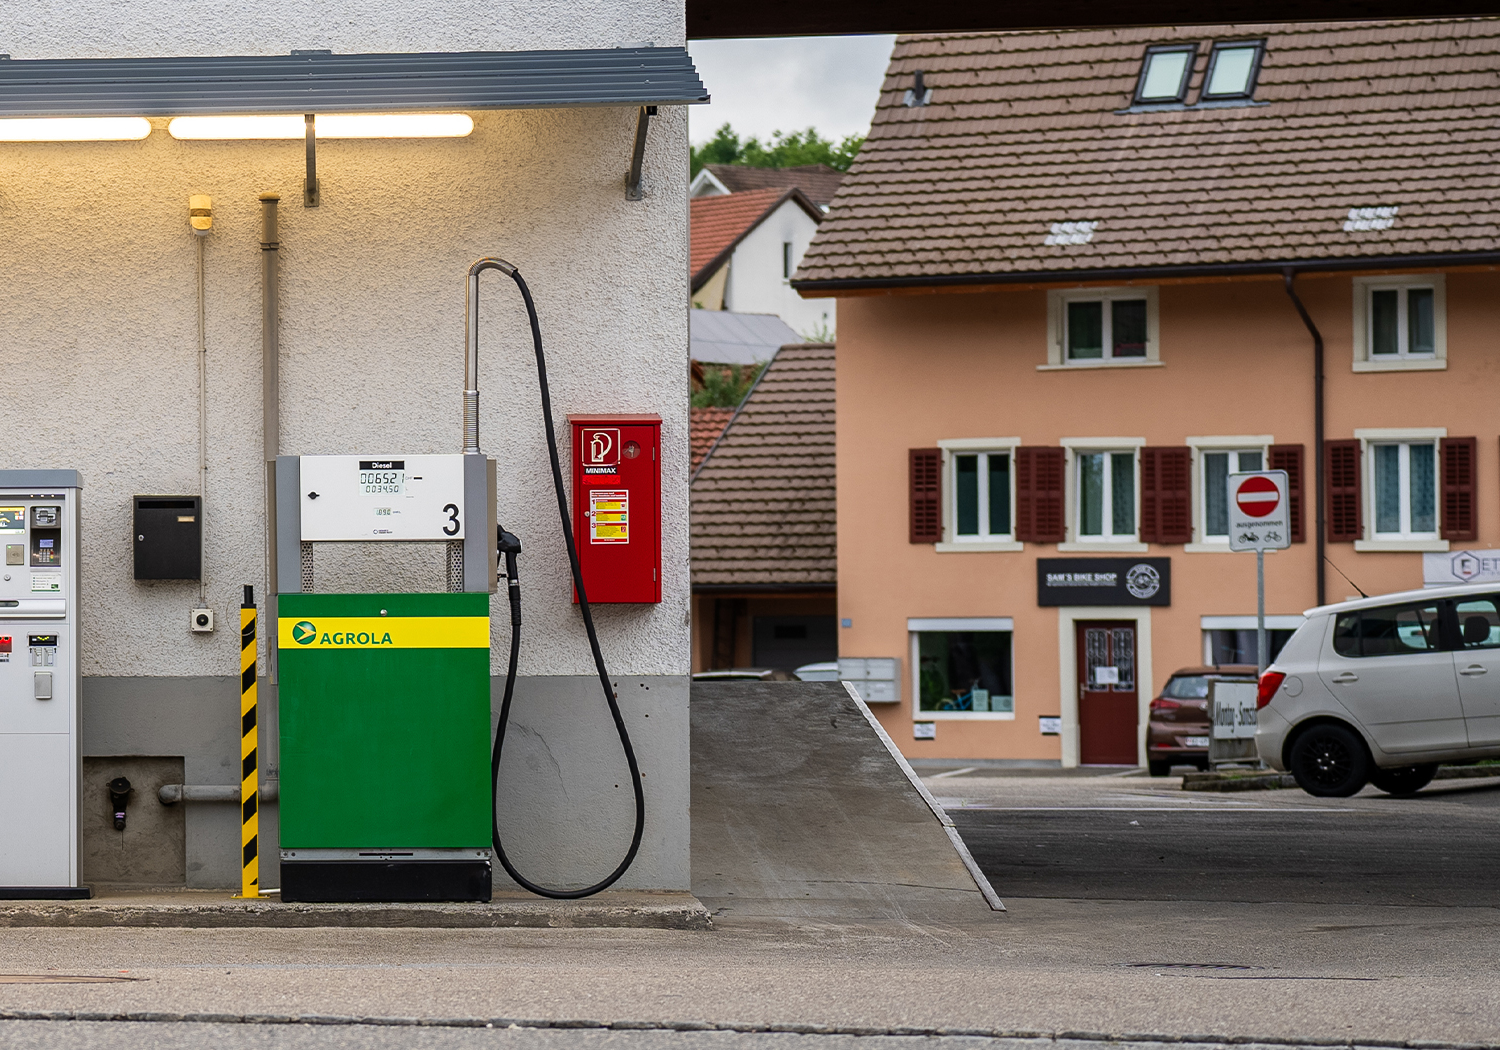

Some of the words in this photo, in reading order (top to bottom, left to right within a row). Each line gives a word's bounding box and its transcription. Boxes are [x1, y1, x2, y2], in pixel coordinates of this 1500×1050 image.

[443, 503, 460, 536] 3
[1235, 520, 1283, 529] ausgenommen
[1074, 573, 1092, 581] BIKE
[1094, 573, 1117, 581] SHOP
[320, 632, 393, 645] AGROLA
[1214, 702, 1234, 733] Montag
